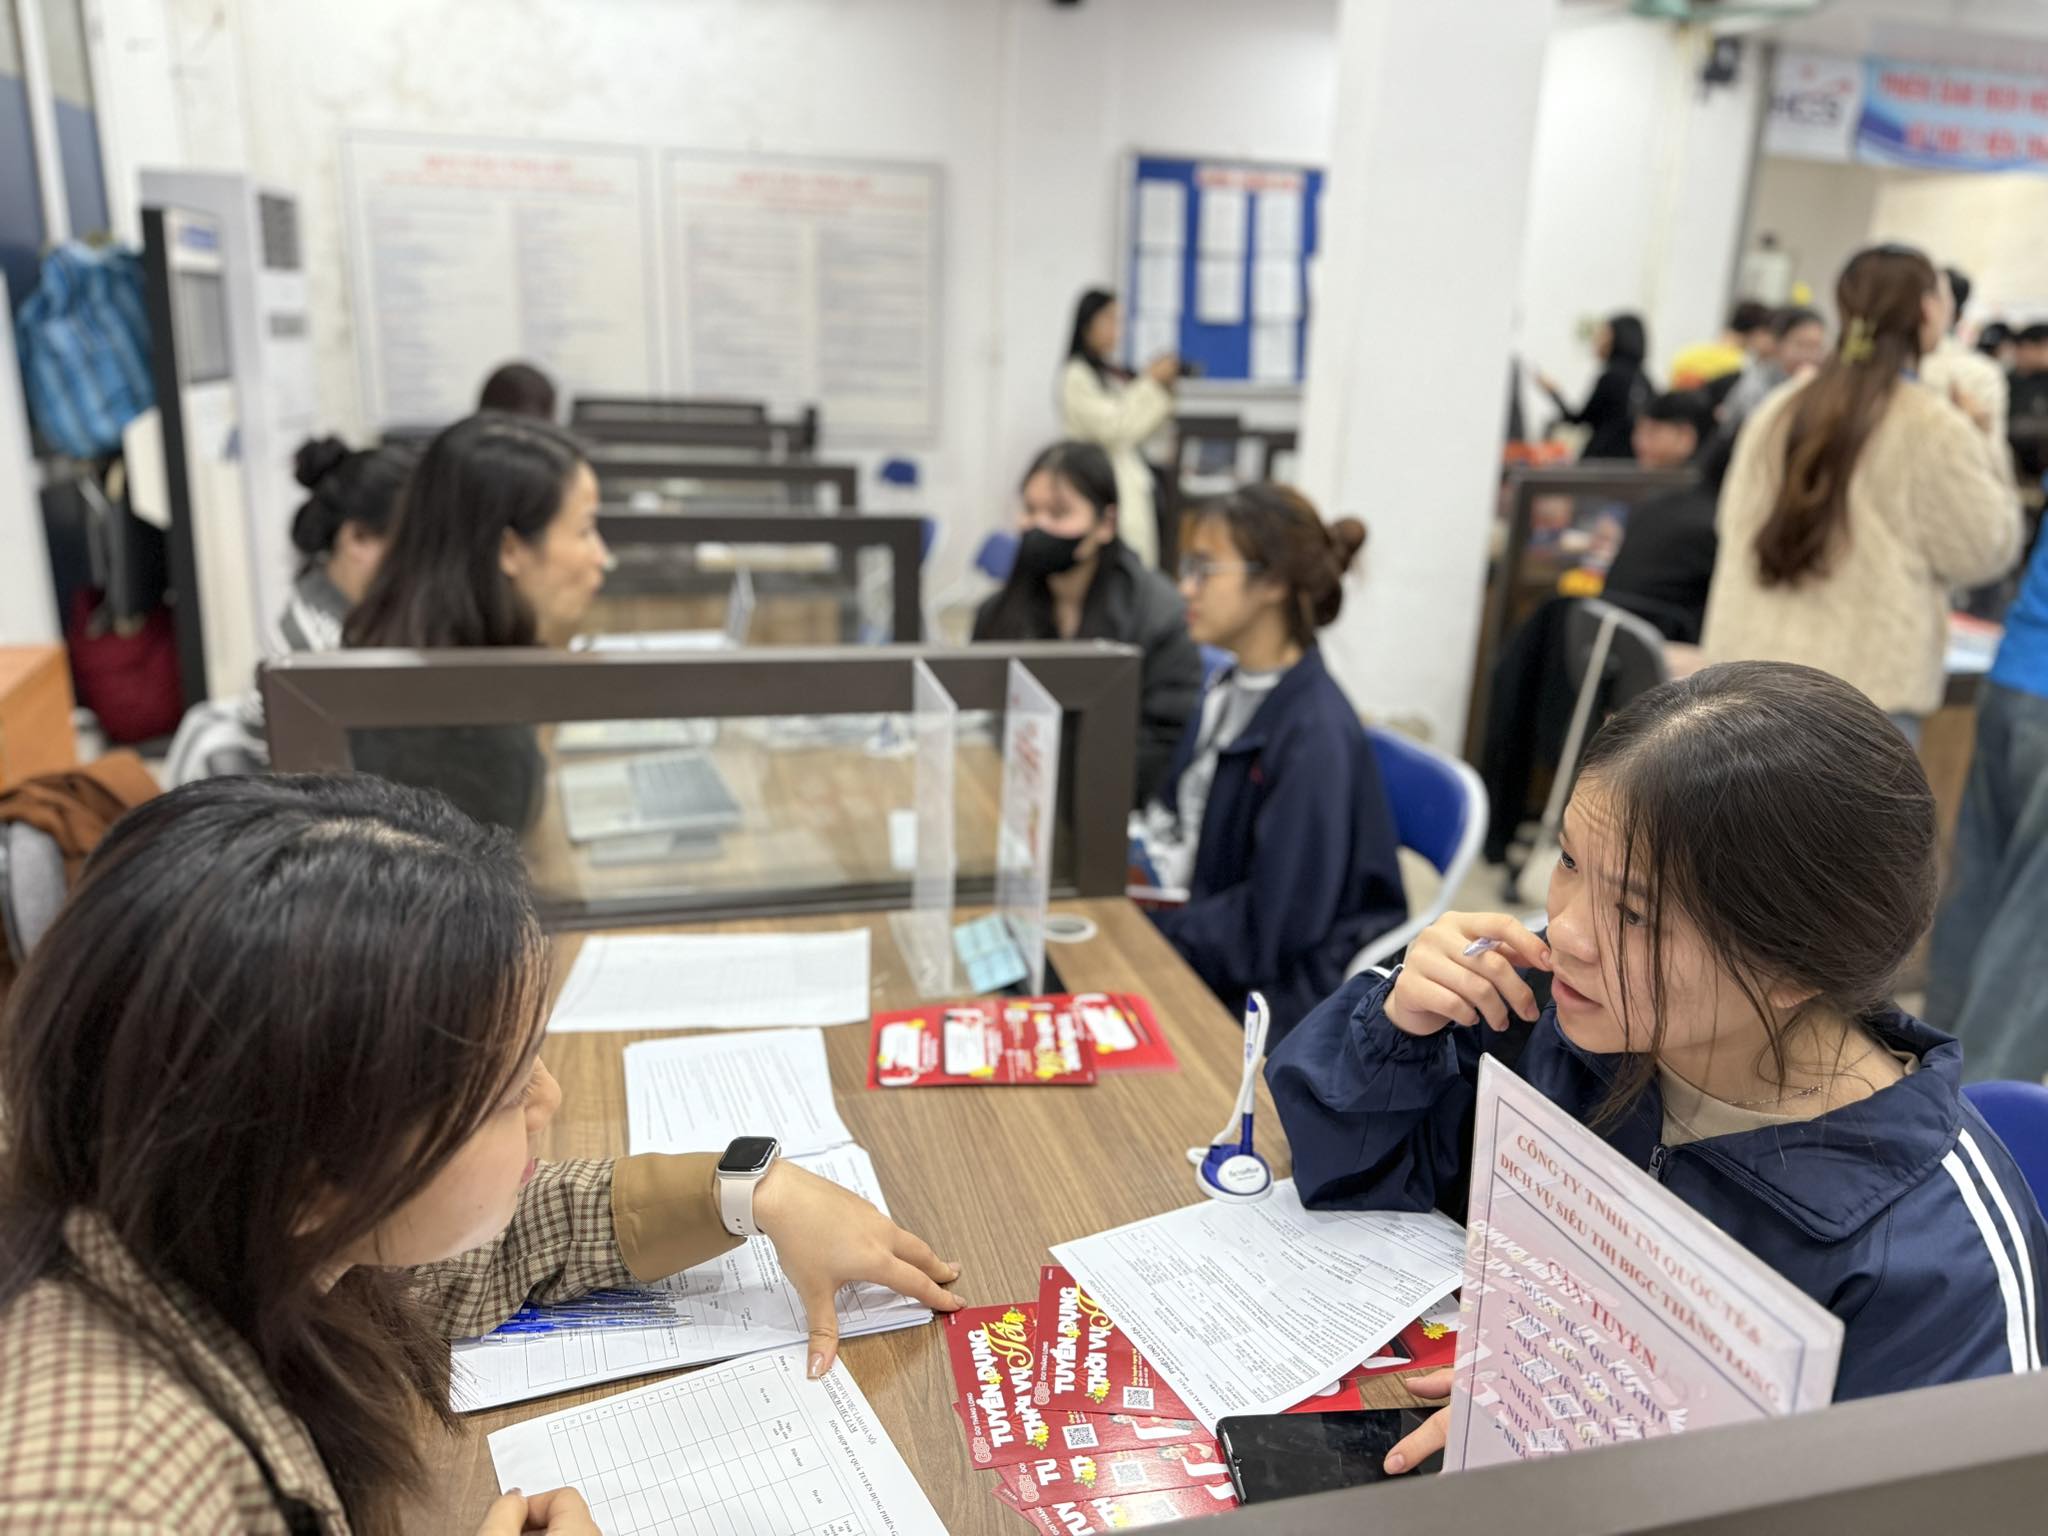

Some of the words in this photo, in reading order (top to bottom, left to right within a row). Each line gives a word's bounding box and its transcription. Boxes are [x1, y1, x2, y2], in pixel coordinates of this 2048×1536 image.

[1500, 1153, 1532, 1190] DỊCH
[1535, 1183, 1554, 1209] VỤ
[1555, 1201, 1588, 1236] SIÊU
[1591, 1229, 1616, 1265] THỊ
[1517, 1135, 1558, 1176] CÔNG
[1562, 1169, 1581, 1195] TY
[1585, 1189, 1628, 1236] TNHH
[1635, 1231, 1659, 1261] TM
[1058, 1286, 1083, 1335] DỤNG
[1087, 1325, 1112, 1351] VỤ
[968, 1328, 1001, 1381] DỤNG
[980, 1313, 1035, 1376] Tết
[1049, 1336, 1079, 1394] TUYỂN
[1080, 1350, 1109, 1393] THỜI
[1008, 1364, 1036, 1394] VỤ
[975, 1383, 1014, 1448] TUYỂN
